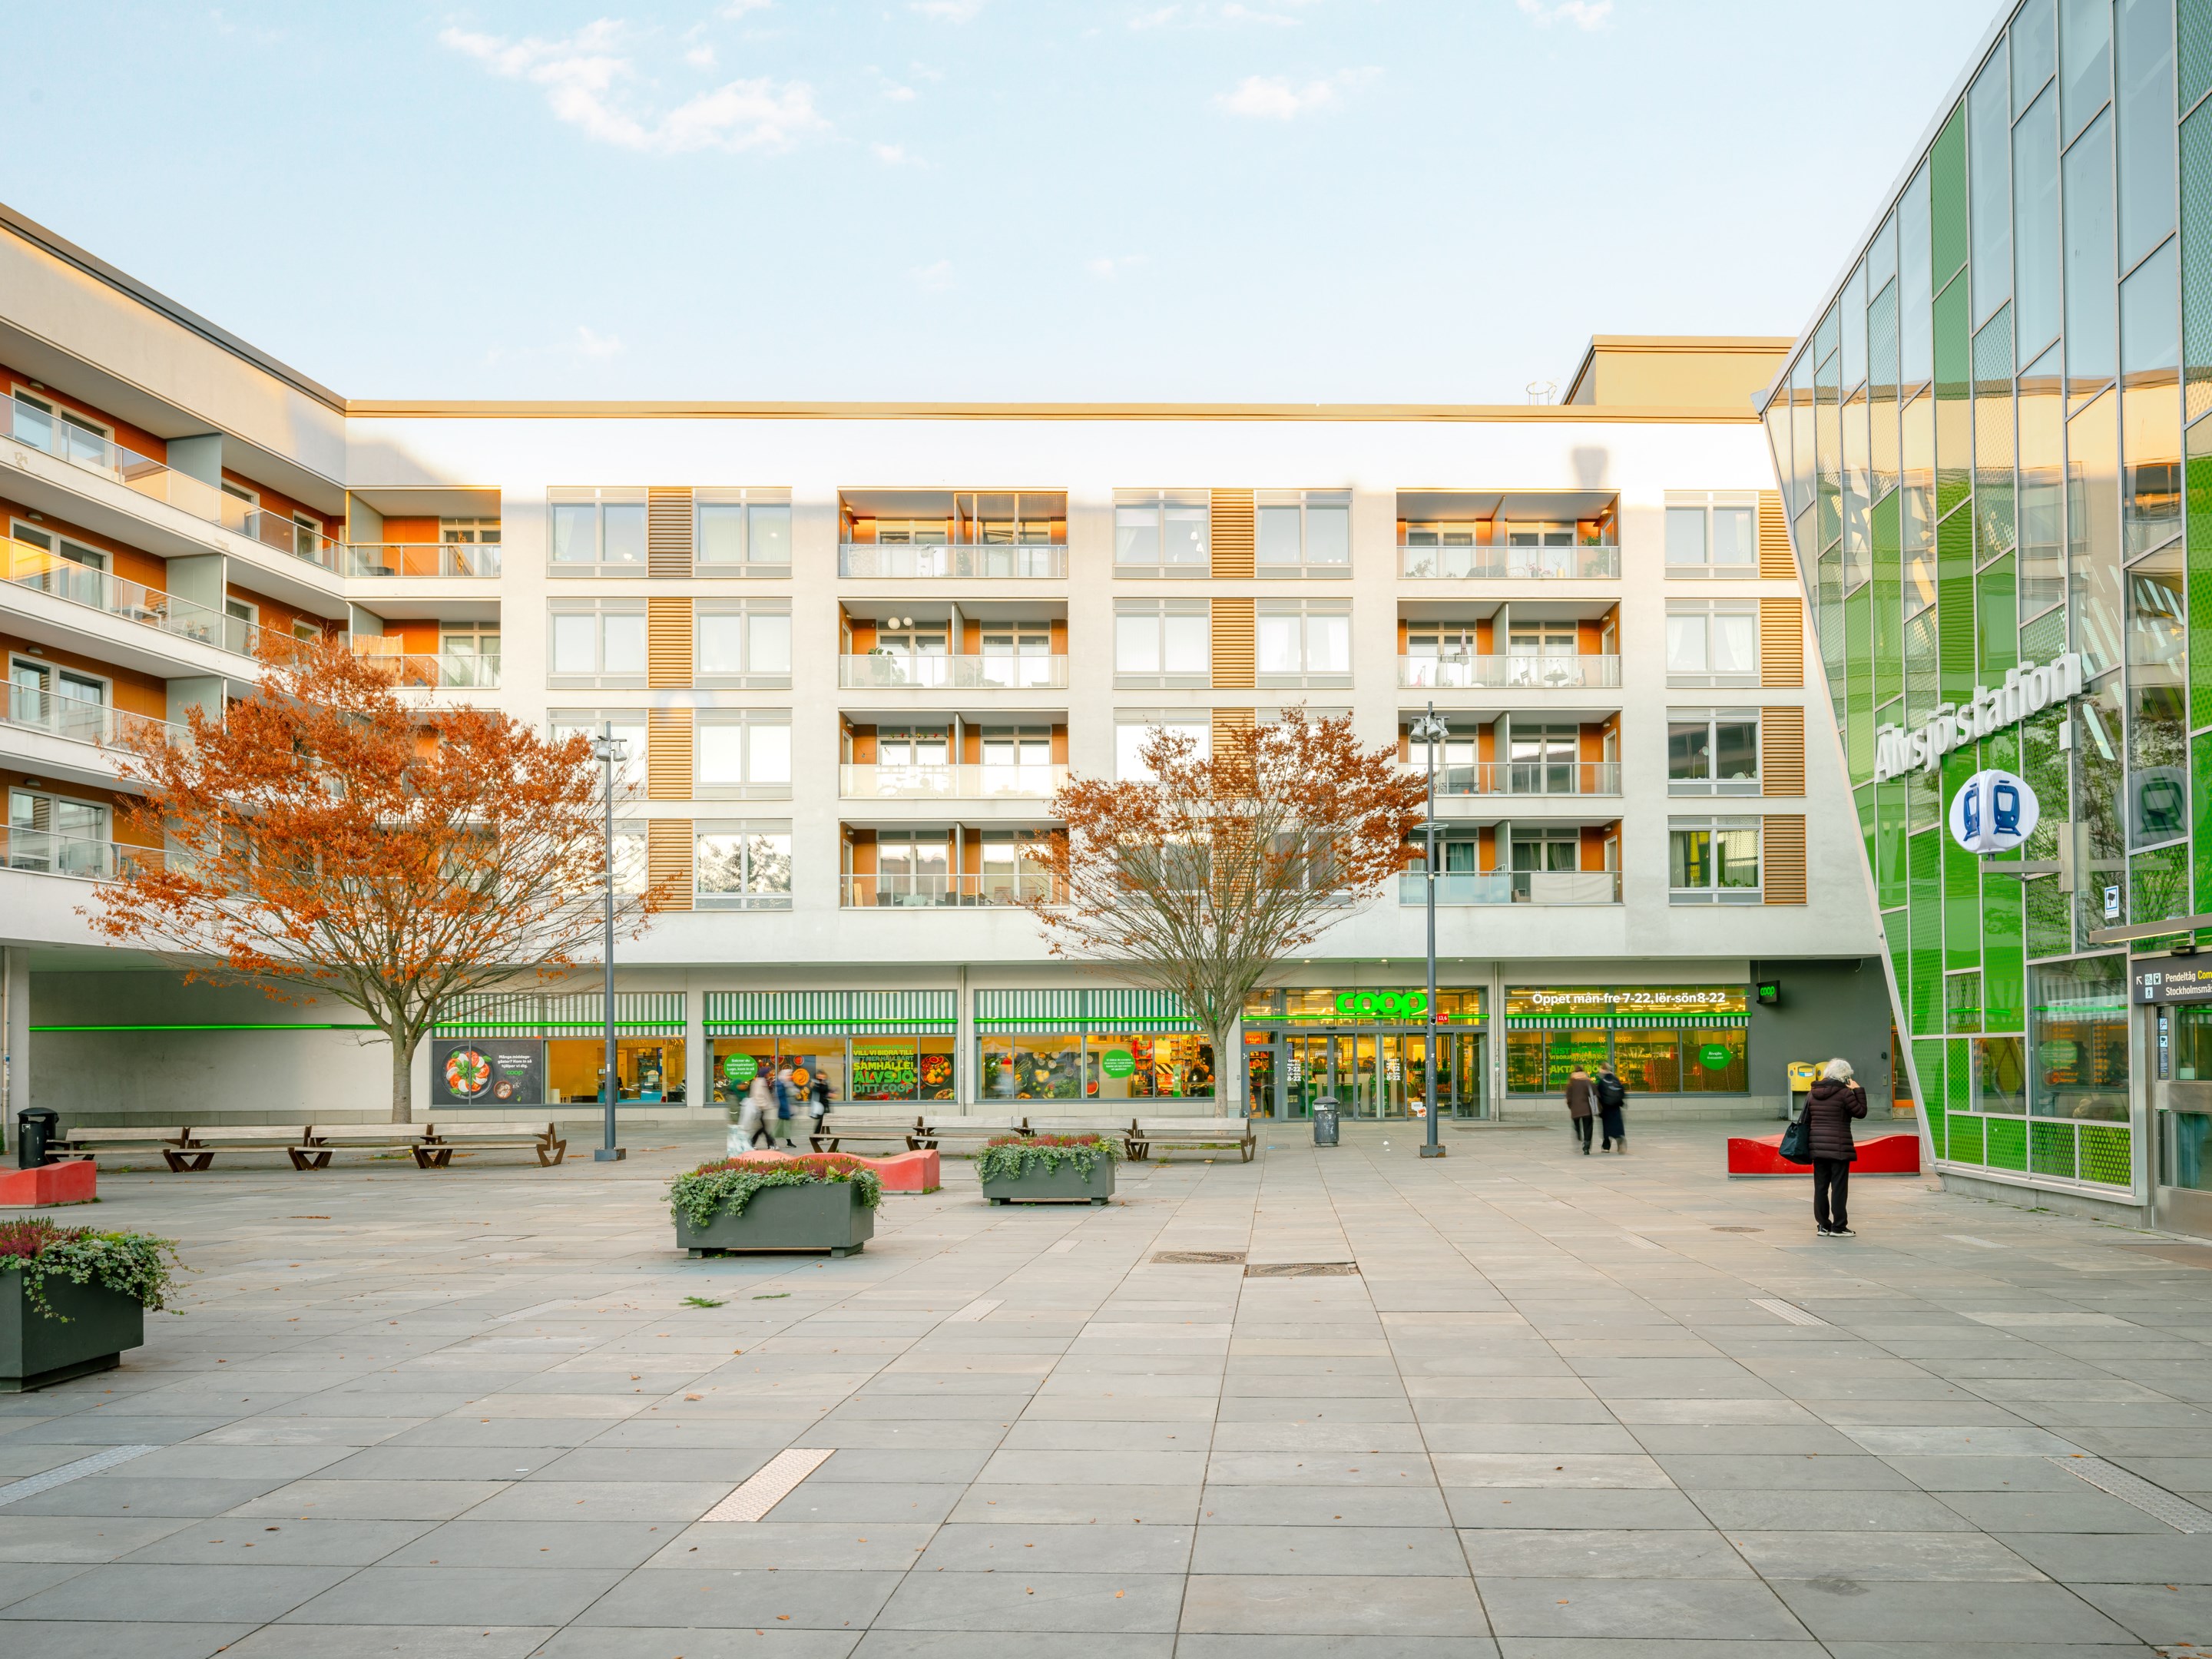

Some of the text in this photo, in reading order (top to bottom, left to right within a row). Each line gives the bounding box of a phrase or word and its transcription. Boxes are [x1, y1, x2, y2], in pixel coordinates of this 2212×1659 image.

[2165, 971, 2196, 982] Pendeltåg
[1760, 985, 1775, 997] coop
[1532, 991, 1571, 1006] Öppet
[1574, 992, 1621, 1004] mån-fre
[1622, 992, 1654, 1005] 7-22,
[1336, 992, 1428, 1019] coop
[1571, 1046, 1589, 1055] FÖR
[853, 1061, 914, 1071] SAMHÄLLE!
[1551, 1065, 1575, 1073] ÄKTA
[853, 1070, 914, 1084] ÄLVSJÖ
[853, 1084, 914, 1094] DITT COOP
